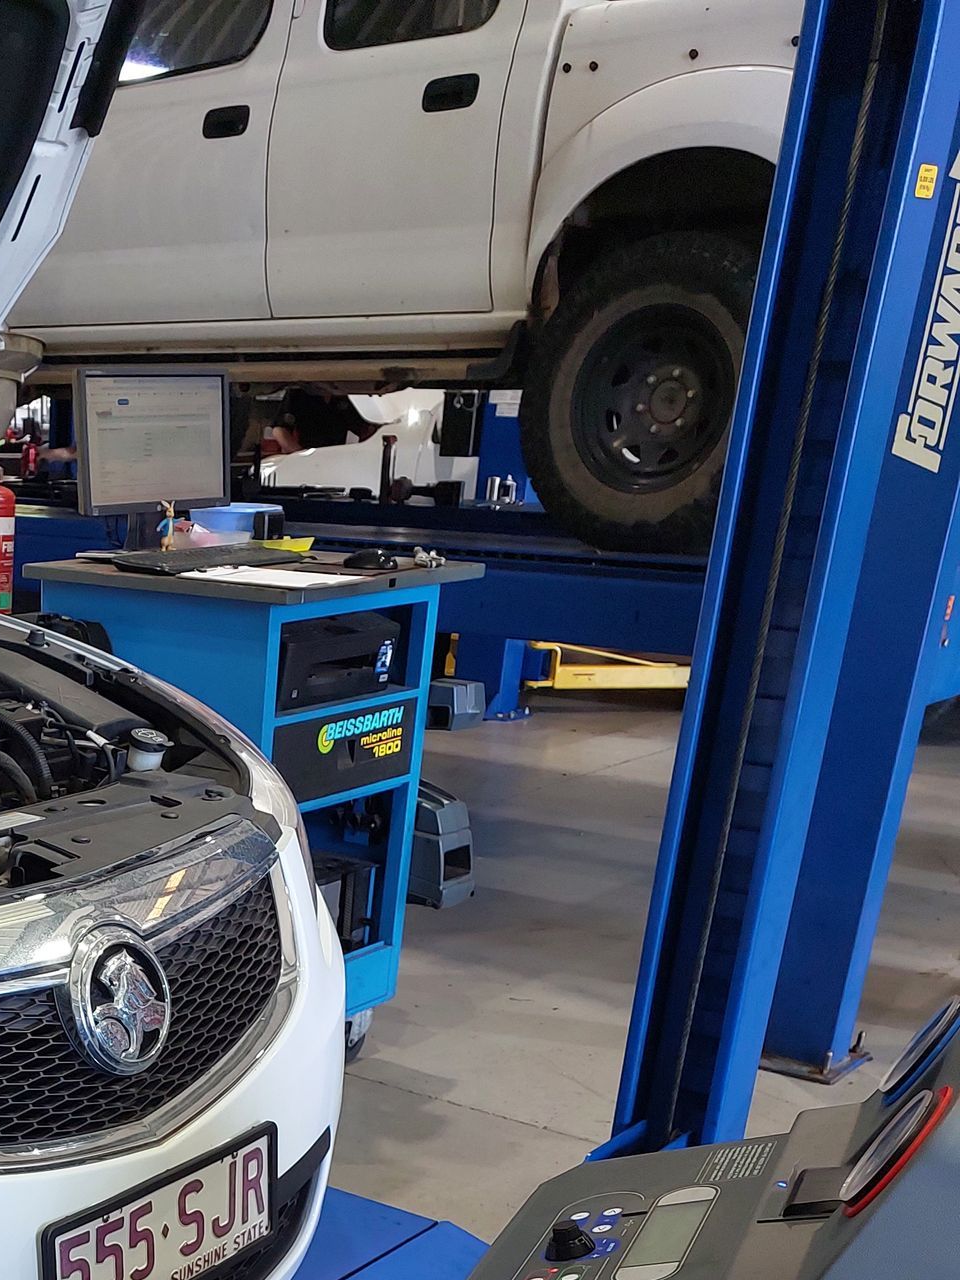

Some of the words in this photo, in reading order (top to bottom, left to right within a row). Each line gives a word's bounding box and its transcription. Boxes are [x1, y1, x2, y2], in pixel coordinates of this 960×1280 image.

[891, 184, 960, 473] FORWA
[326, 706, 404, 740] BEISSBARTH
[360, 727, 403, 746] microline
[373, 740, 401, 758] 1800
[233, 1219, 265, 1251] STATE
